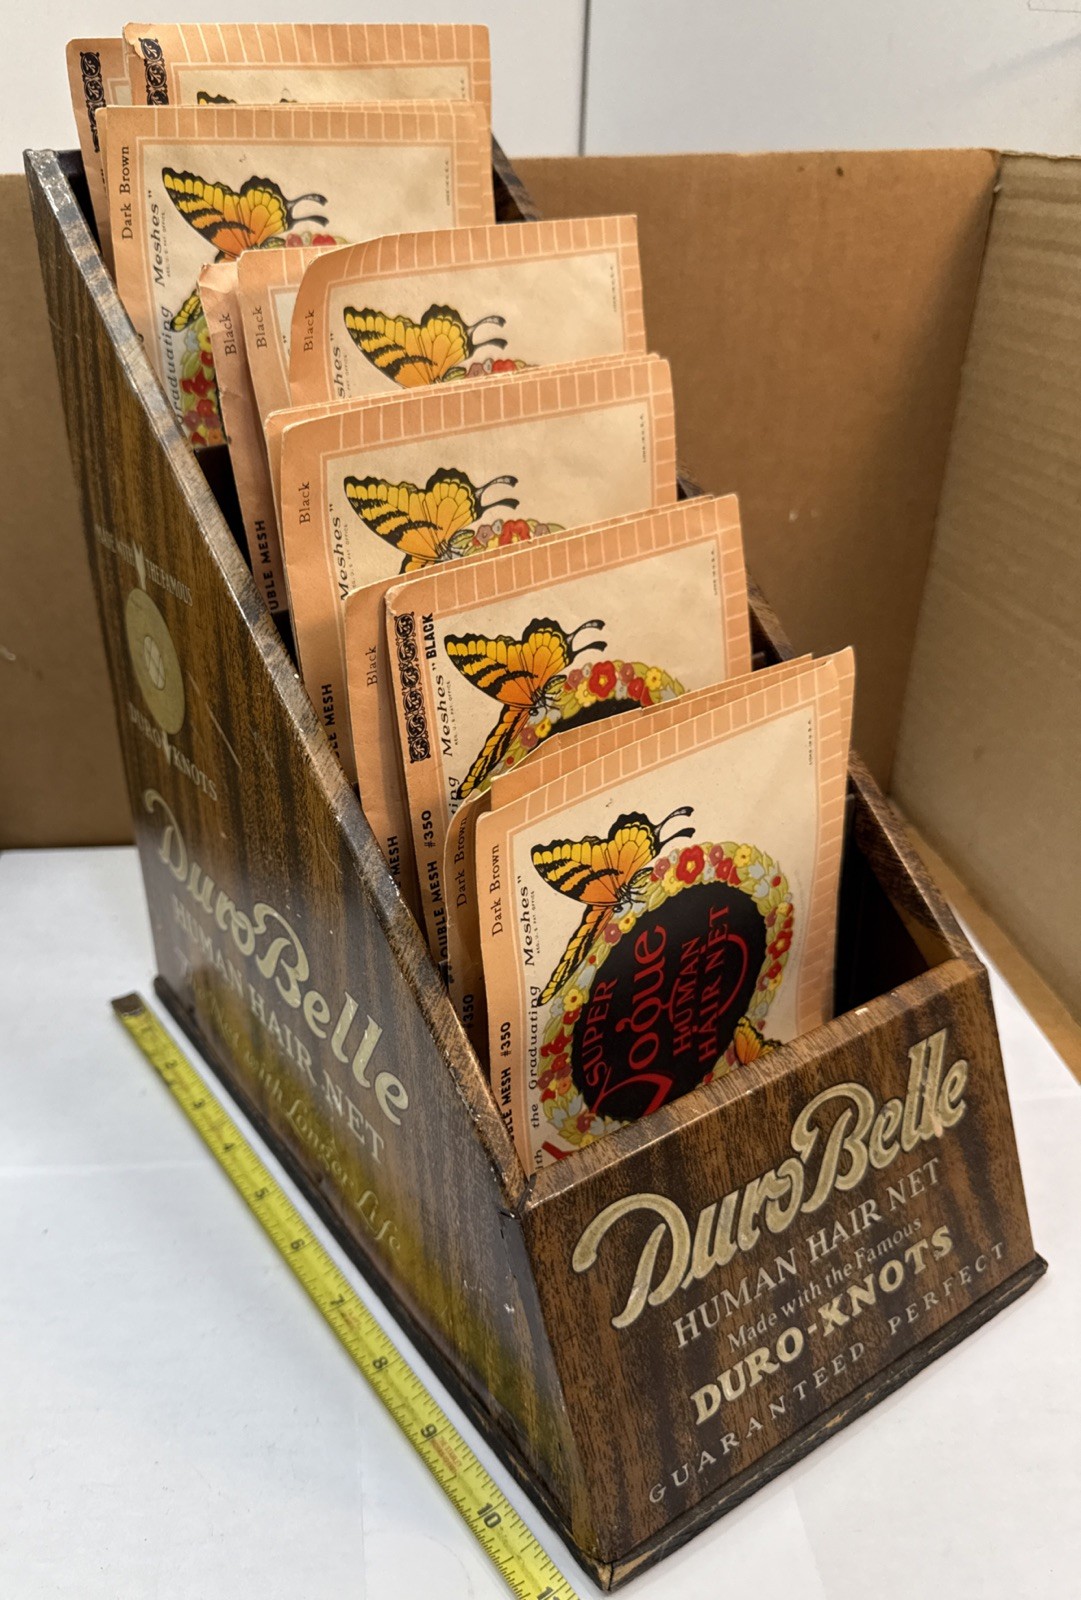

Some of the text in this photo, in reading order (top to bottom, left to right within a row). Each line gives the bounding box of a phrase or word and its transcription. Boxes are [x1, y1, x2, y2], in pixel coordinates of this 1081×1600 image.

[120, 146, 133, 240] Dark Brown
[219, 313, 237, 356] Black
[253, 305, 267, 348] Black
[303, 310, 315, 352] Black
[330, 333, 345, 399] shes"
[298, 481, 310, 525] Black
[255, 520, 279, 611] UBLE MESH
[422, 613, 437, 660] BLACK
[365, 645, 378, 687] Black
[321, 684, 336, 726] MESH
[387, 836, 400, 875] MESH
[454, 816, 468, 909] Dark Brown
[421, 810, 448, 958] OUBLE MESH #350
[489, 844, 503, 937] Dark Brown
[673, 936, 701, 1057] HUMAN
[698, 905, 730, 1062] HAIR NET
[501, 1021, 512, 1057] #350
[528, 986, 541, 1090] Graduating
[582, 978, 618, 1087] SUPER
[249, 982, 318, 1087] HAIR
[322, 1070, 385, 1166] NET
[501, 1067, 512, 1106] MESH
[193, 1098, 206, 1110] 3
[530, 1104, 539, 1129] the
[222, 1142, 236, 1153] 4
[534, 1149, 544, 1170] ith
[254, 1186, 269, 1200] 5
[354, 1189, 401, 1251] Life
[289, 1238, 306, 1251] 6
[672, 1157, 941, 1350] HUMAN HAIR NET
[329, 1293, 346, 1307] 7
[726, 1217, 923, 1353] Made with the Famous
[689, 1224, 953, 1426] DURO-KNOTS
[372, 1356, 389, 1370] 8
[648, 1242, 1005, 1504] GUARANTEED PERFECT
[420, 1423, 438, 1439] 9
[476, 1502, 502, 1530] 10
